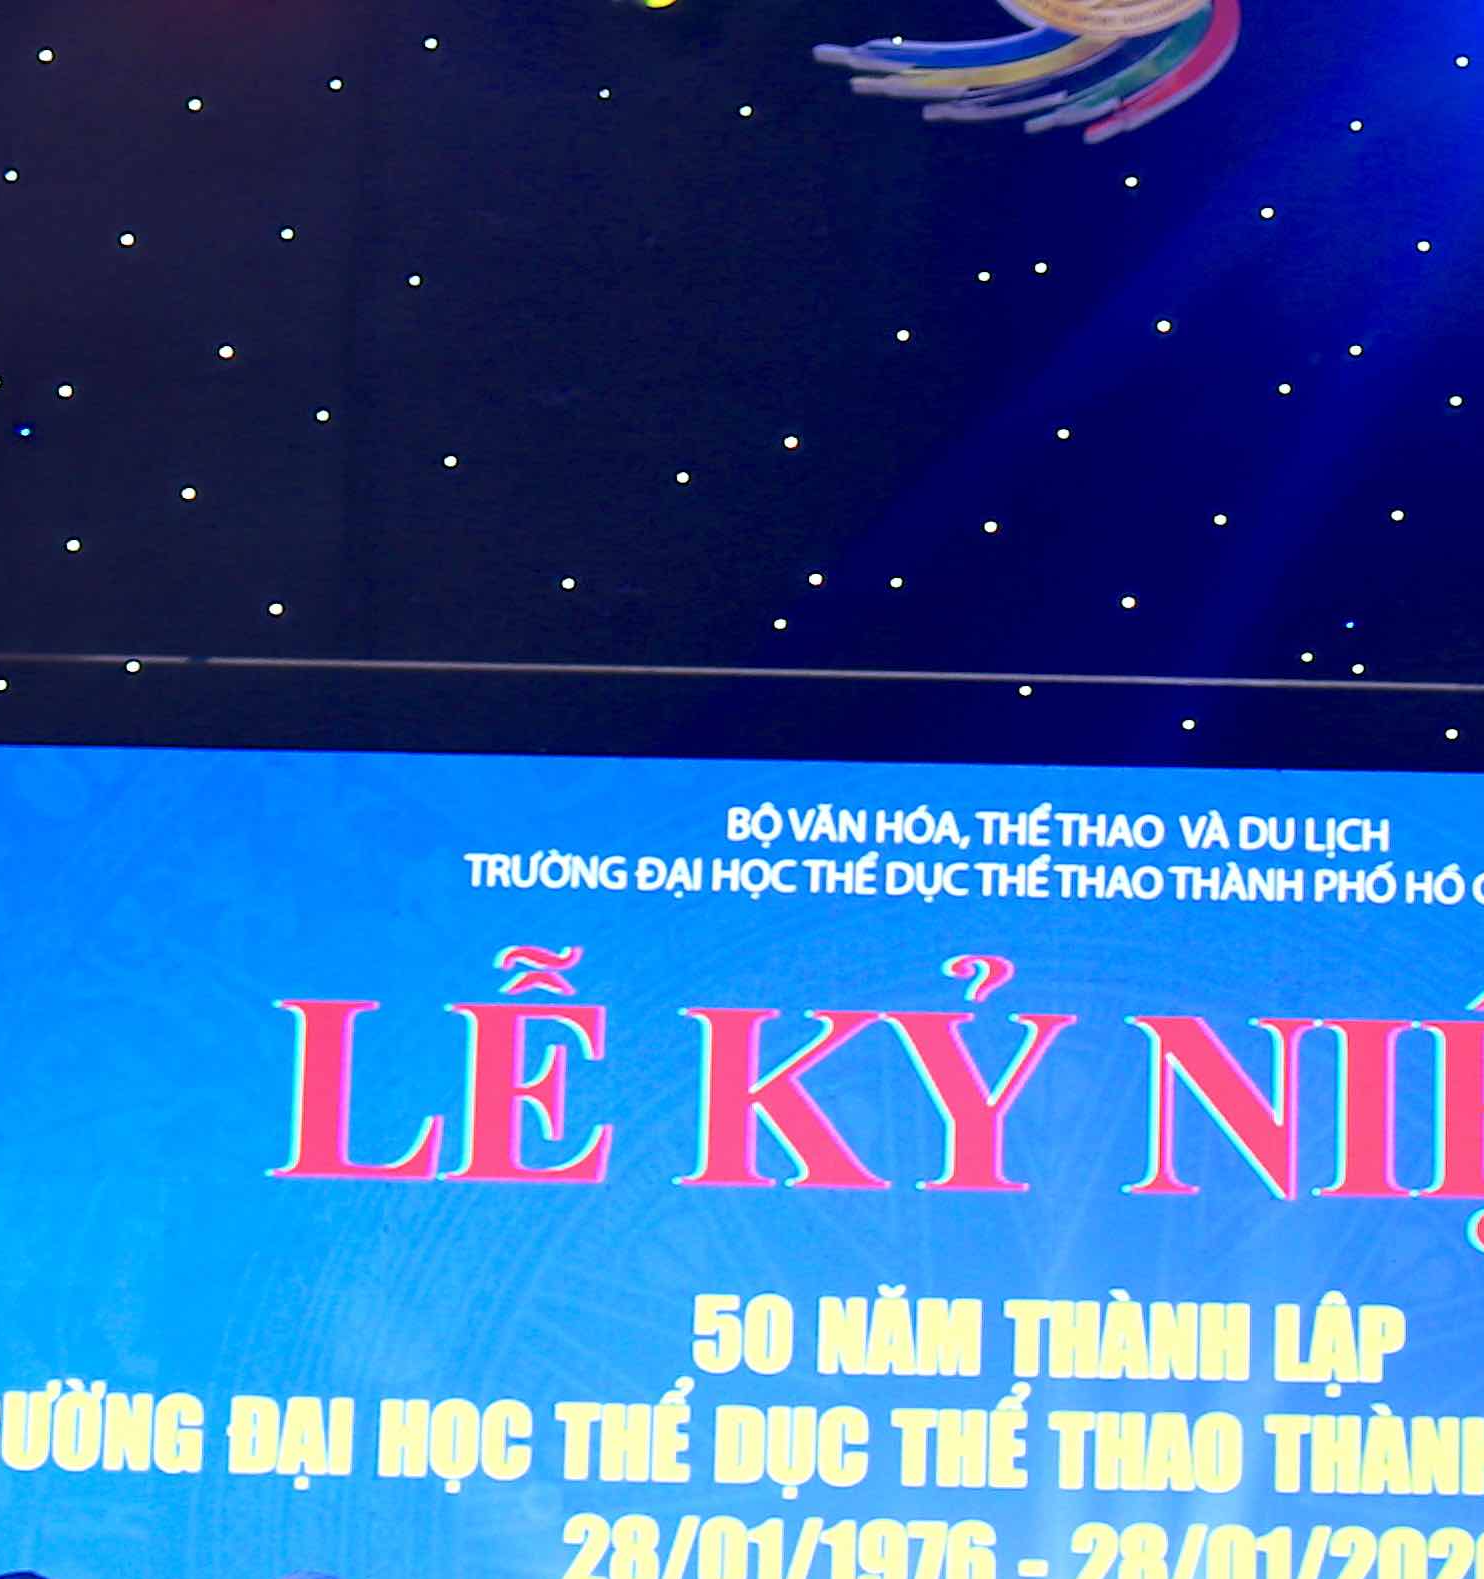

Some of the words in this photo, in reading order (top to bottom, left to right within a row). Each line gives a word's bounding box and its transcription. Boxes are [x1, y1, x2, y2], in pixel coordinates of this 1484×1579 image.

[727, 803, 785, 848] BỘ
[788, 803, 867, 844] VĂN
[875, 804, 970, 850] HÓA,
[974, 802, 1053, 847] THỂ
[1054, 812, 1165, 849] THAO
[1179, 810, 1230, 849] VÀ
[1239, 815, 1295, 851] DU
[1305, 815, 1389, 858] LỊCH
[464, 849, 628, 891] TRƯỜNG
[635, 858, 703, 898] ĐẠI
[712, 859, 797, 900] HỌC
[802, 850, 879, 896] THỂ
[885, 860, 969, 903] DỤC
[974, 853, 1052, 898] THỂ
[1054, 863, 1164, 901] THAO
[1169, 860, 1304, 902] THÀNH
[1314, 860, 1397, 905] PHỐ
[266, 945, 613, 1185] LỄ
[674, 953, 1078, 1193] KỶ
[693, 1292, 794, 1375] 50
[818, 1284, 983, 1377] NĂM
[1002, 1287, 1251, 1382] THÀNH
[1273, 1290, 1406, 1398] LẬP
[227, 1396, 355, 1491] ĐẠI
[378, 1398, 533, 1494] HỌC
[555, 1375, 696, 1482] THỂ
[714, 1405, 869, 1501] DỤC
[891, 1382, 1034, 1491] THỂ
[1048, 1411, 1244, 1493] THAO
[1018, 1558, 1049, 1579] -
